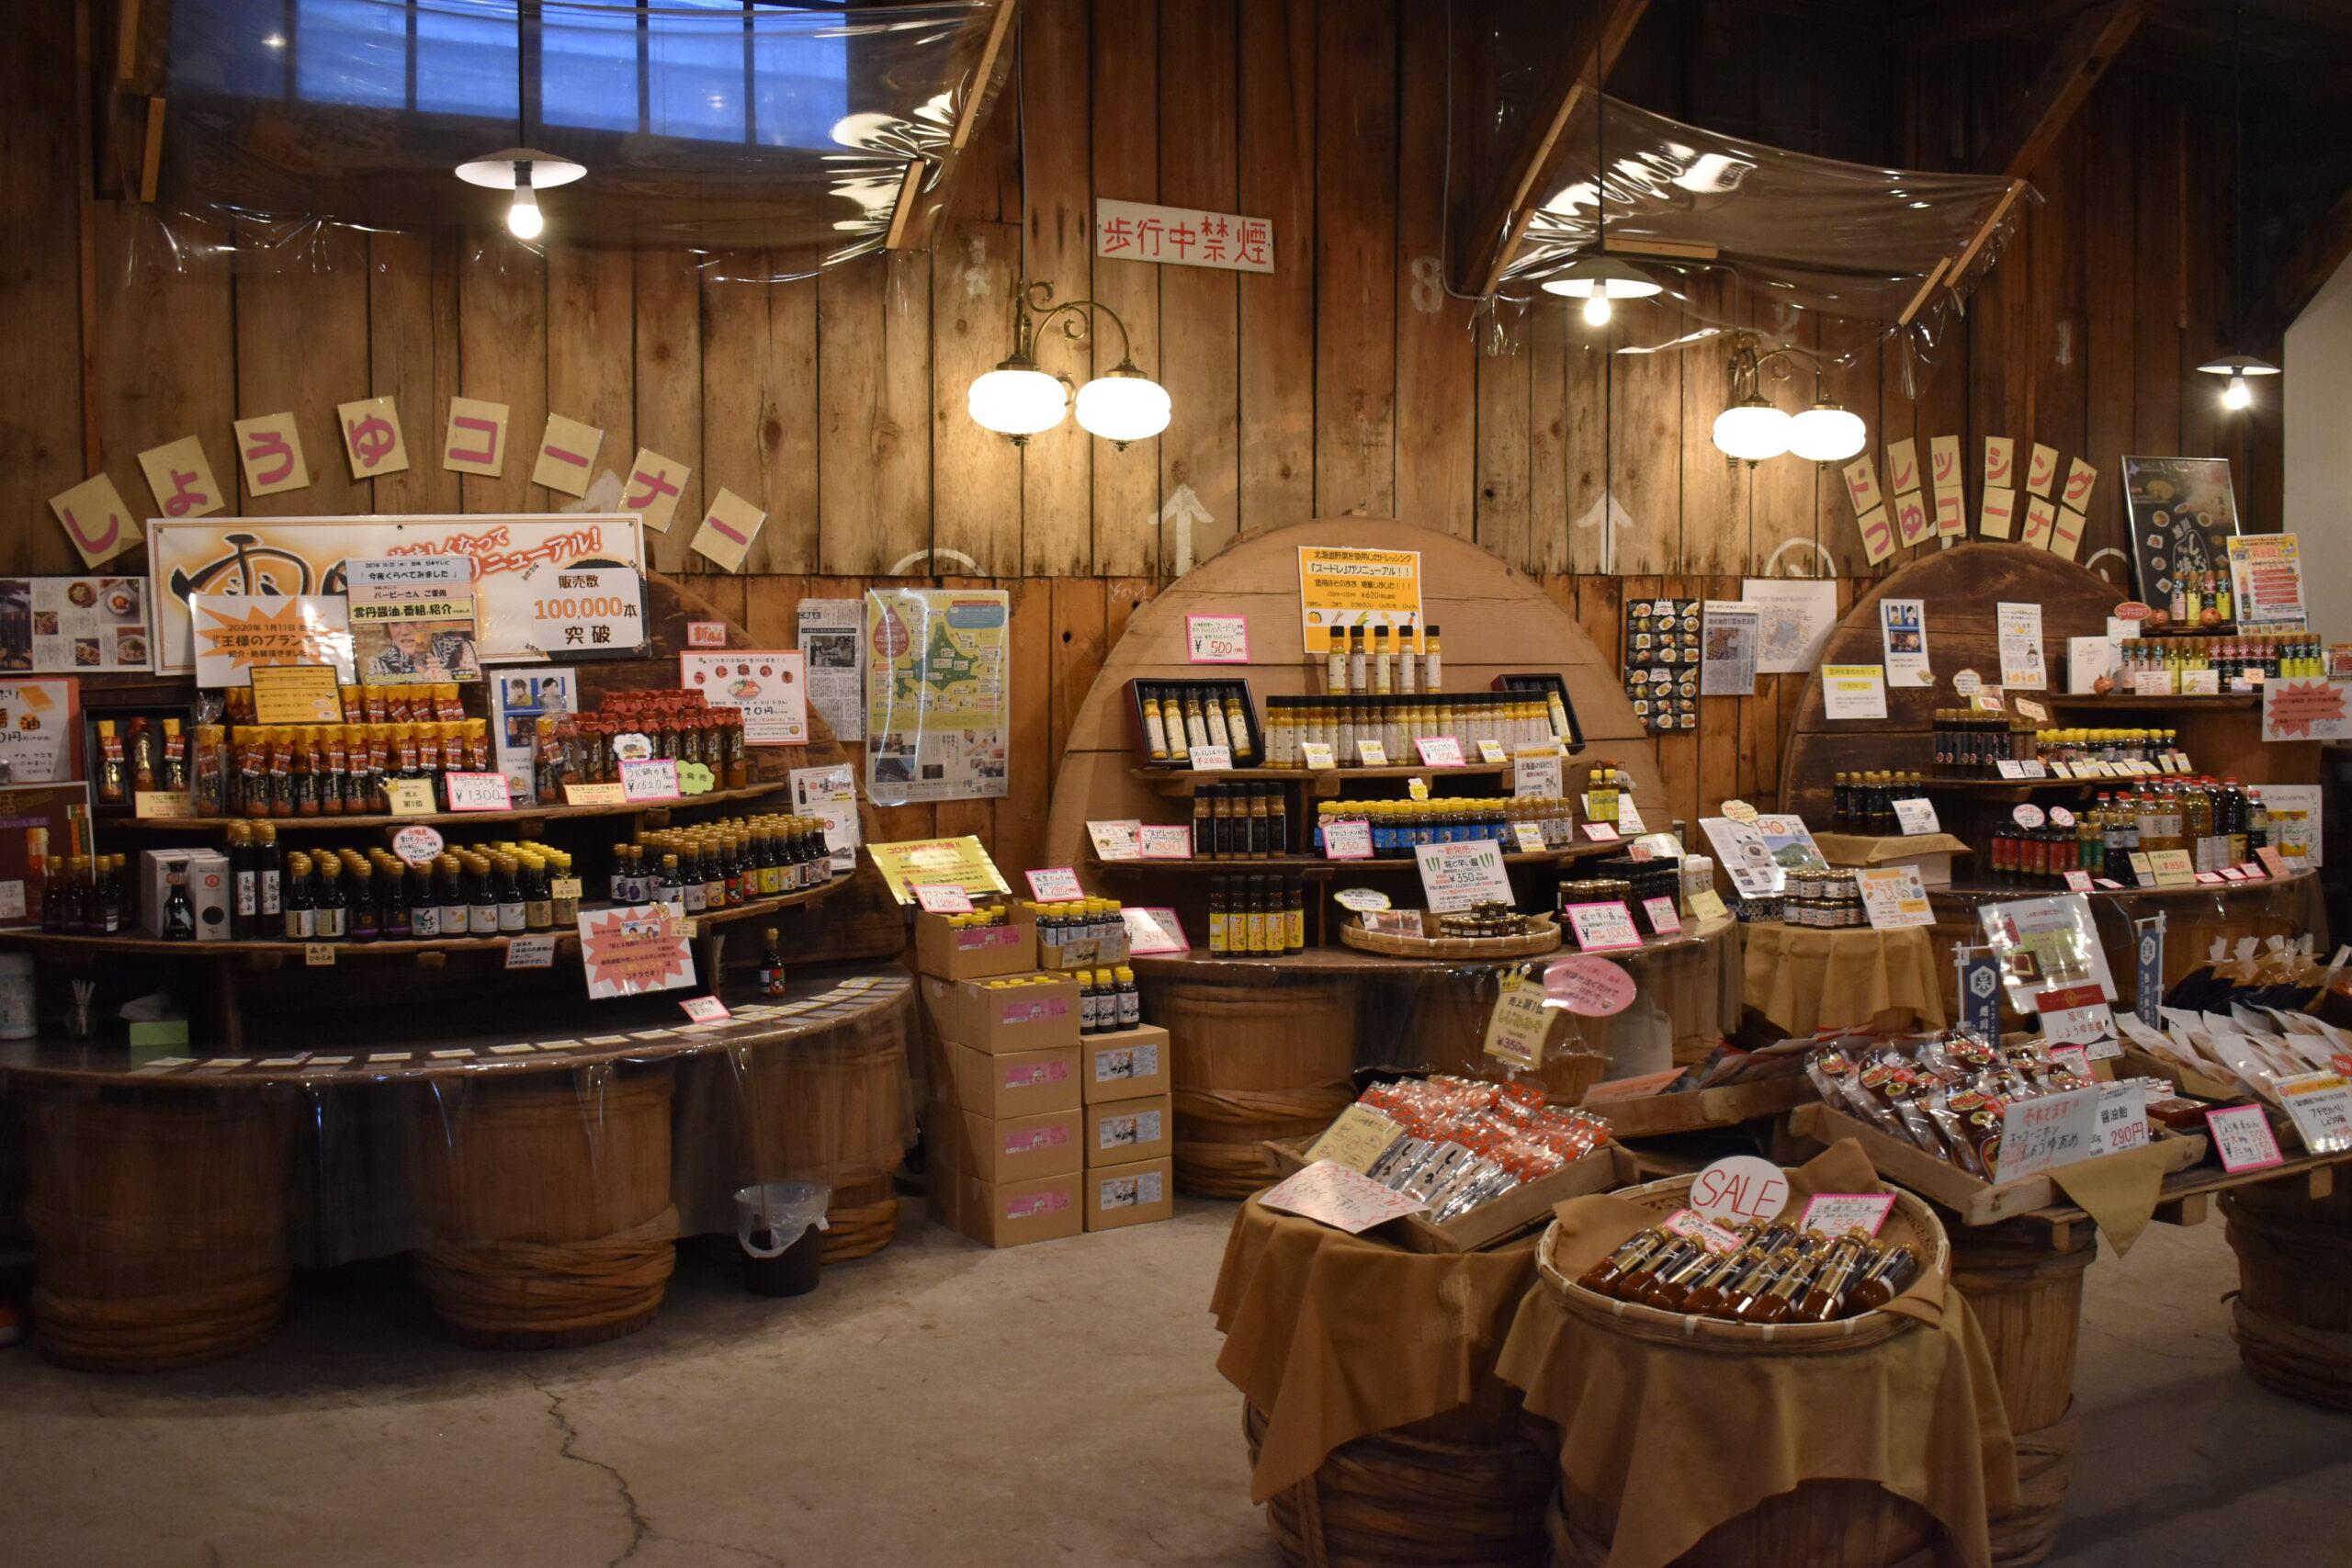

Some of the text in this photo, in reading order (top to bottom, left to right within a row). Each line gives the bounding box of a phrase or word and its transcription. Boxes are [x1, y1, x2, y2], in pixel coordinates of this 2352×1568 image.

[1103, 217, 1267, 265] 歩行中禁煙
[559, 574, 600, 589] 販売数
[534, 596, 639, 620] 100,000本
[565, 626, 611, 645] 突破
[1449, 873, 1475, 883] ¥350
[2101, 1105, 2128, 1124] 醤油飴
[2111, 1122, 2144, 1147] 290円
[1693, 1168, 1784, 1220] SALE
